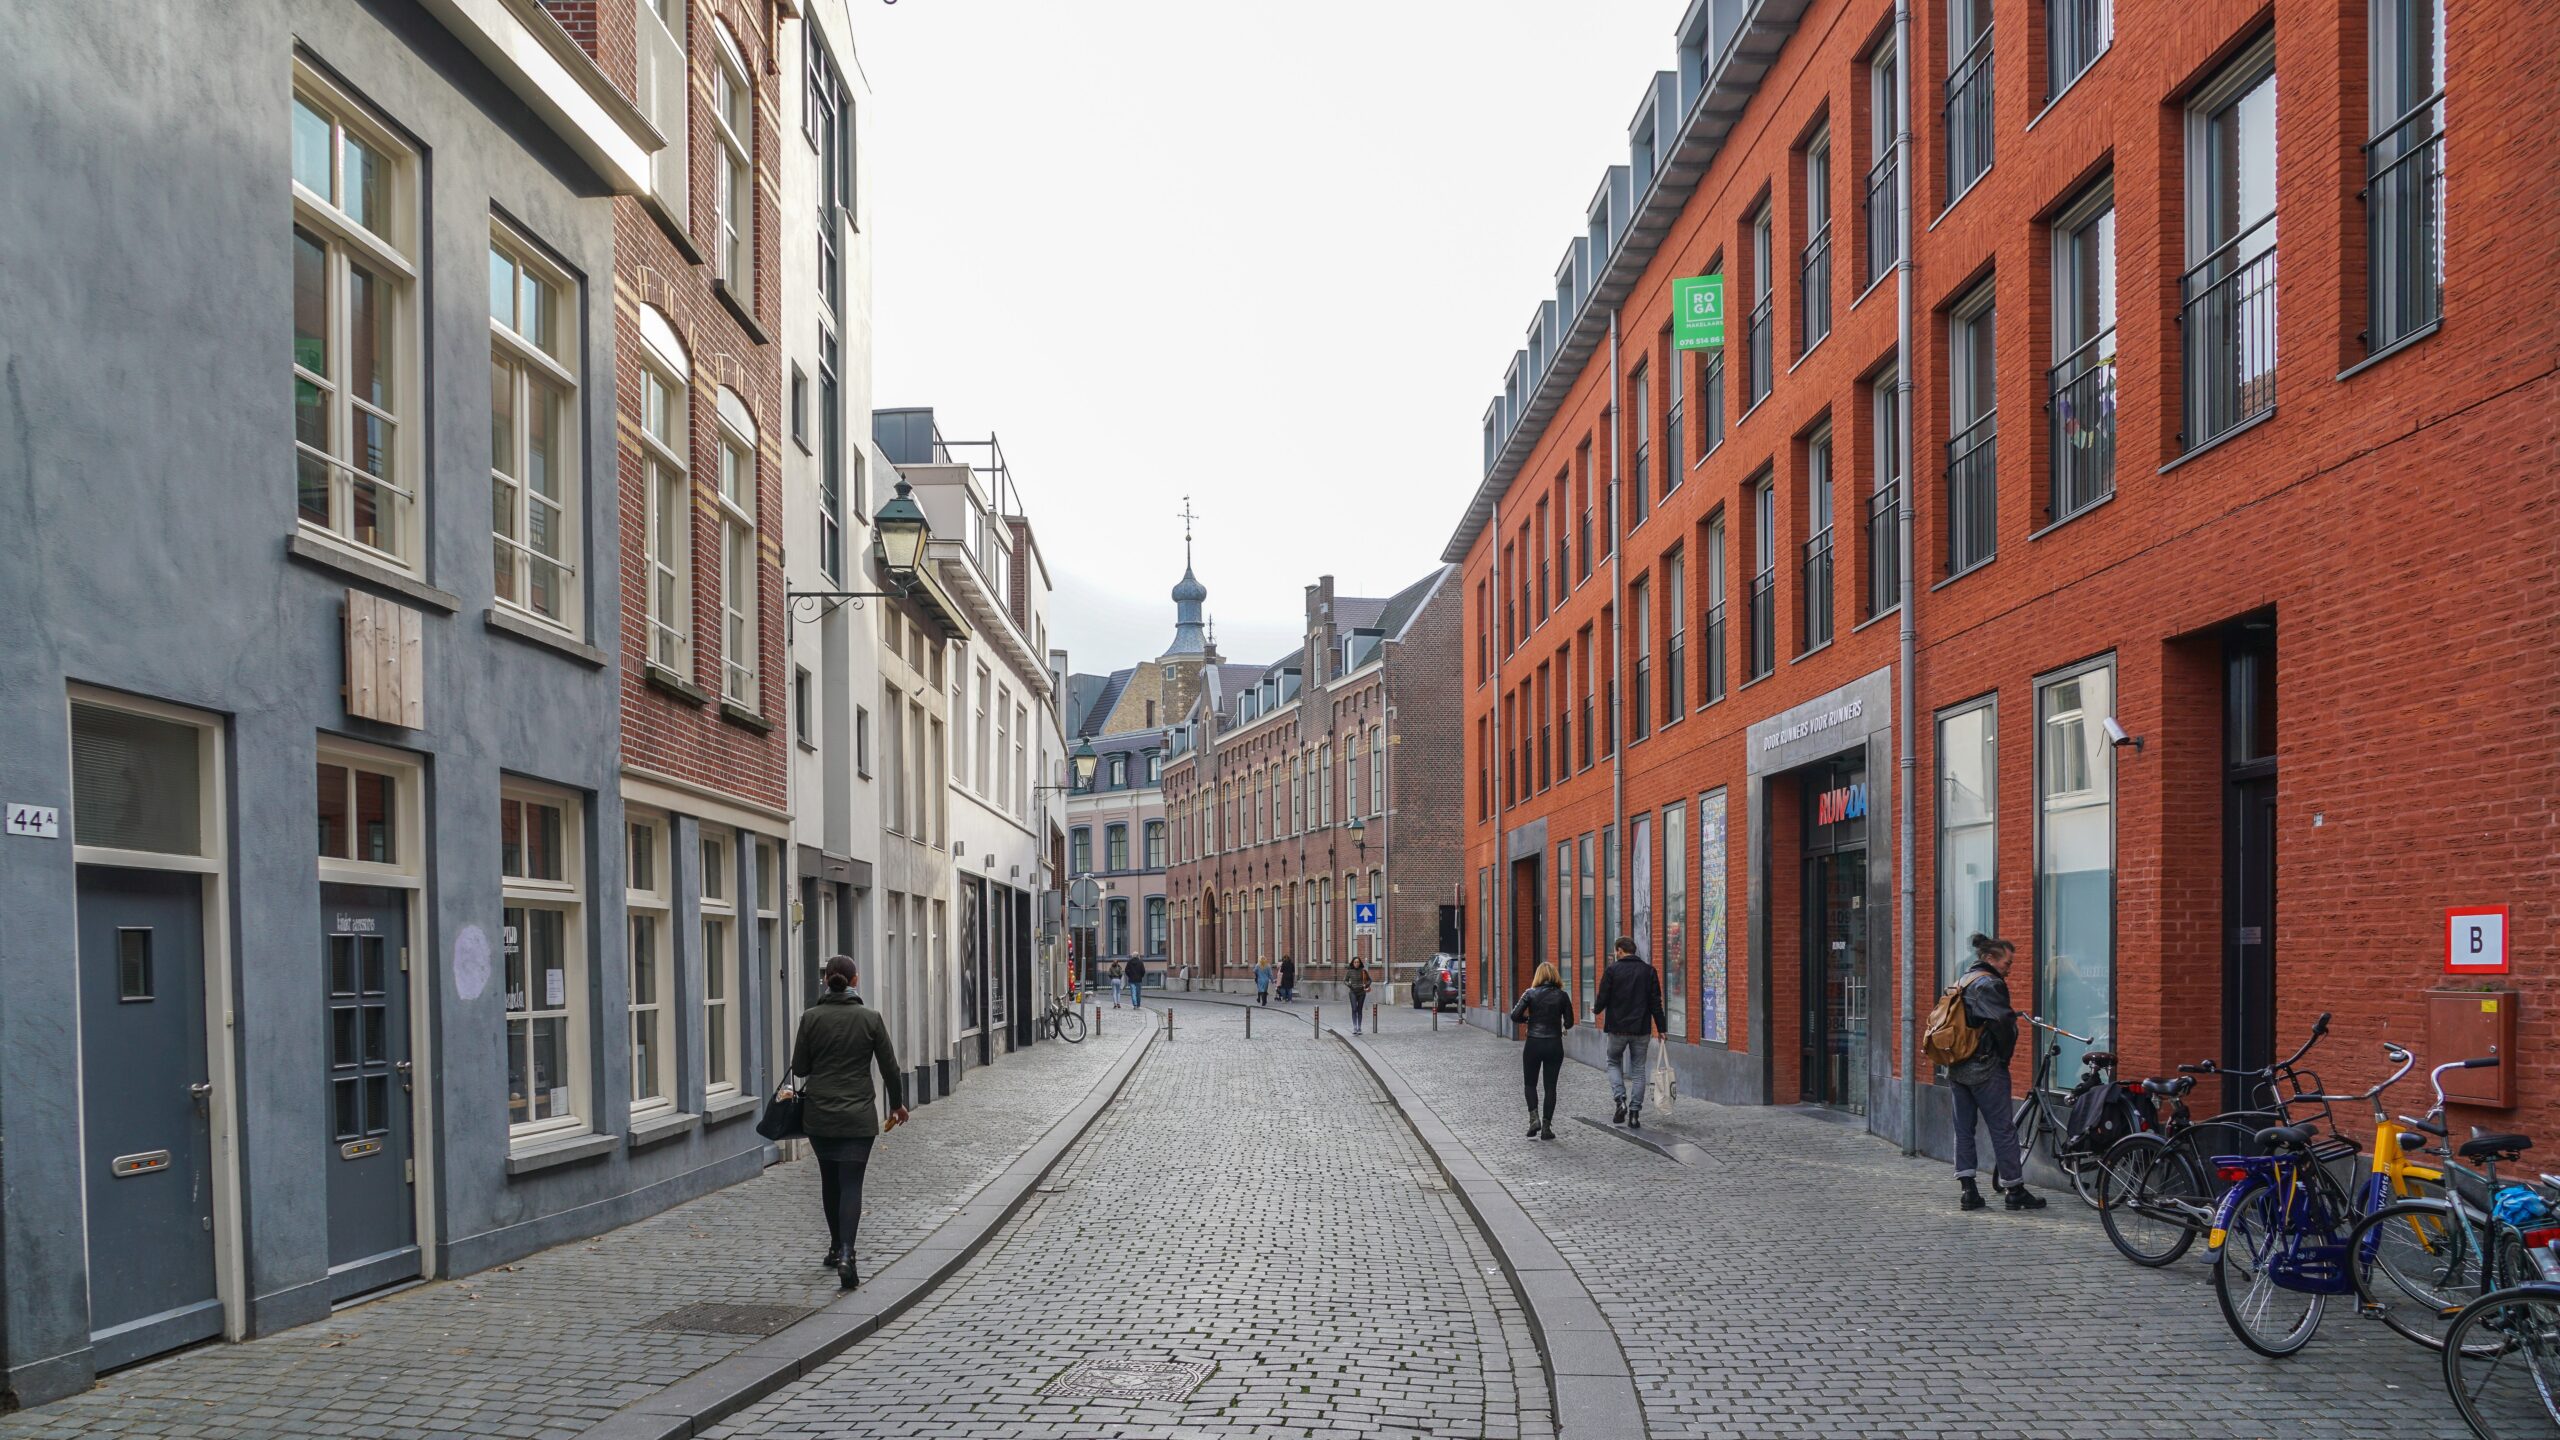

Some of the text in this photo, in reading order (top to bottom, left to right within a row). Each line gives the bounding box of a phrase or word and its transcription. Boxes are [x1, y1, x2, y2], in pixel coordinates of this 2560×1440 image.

[1693, 292, 1715, 304] RO
[1693, 303, 1715, 315] GA
[1763, 699, 1863, 751] DOOR RUNNERS VOOR RUNNERS
[2469, 926, 2483, 953] B
